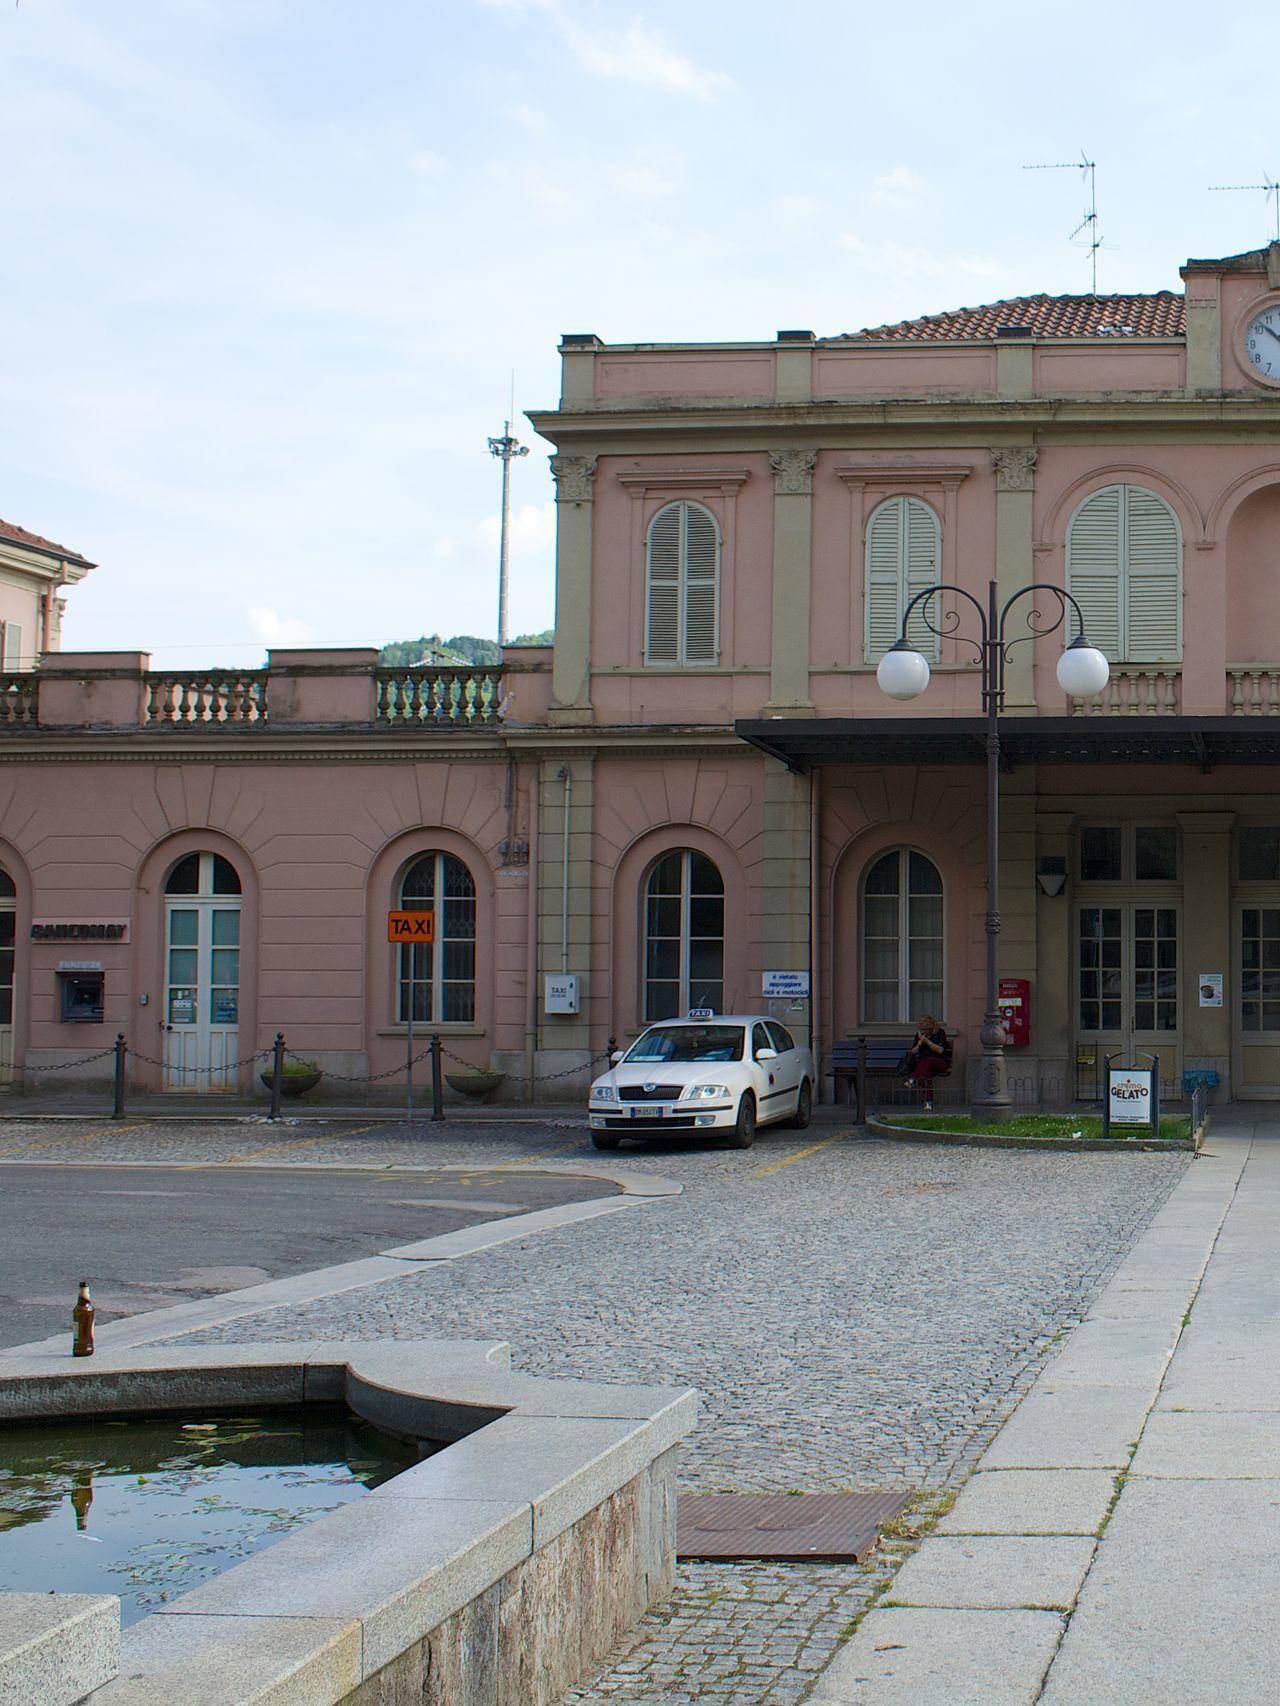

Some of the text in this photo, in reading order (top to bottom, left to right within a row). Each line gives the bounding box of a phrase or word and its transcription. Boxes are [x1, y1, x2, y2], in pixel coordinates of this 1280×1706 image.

[1255, 325, 1263, 334] 10
[1250, 340, 1256, 349] 9
[1255, 354, 1261, 363] 8
[1267, 363, 1271, 372] 7
[391, 919, 431, 934] TAXI
[1111, 1086, 1149, 1099] GELATO
